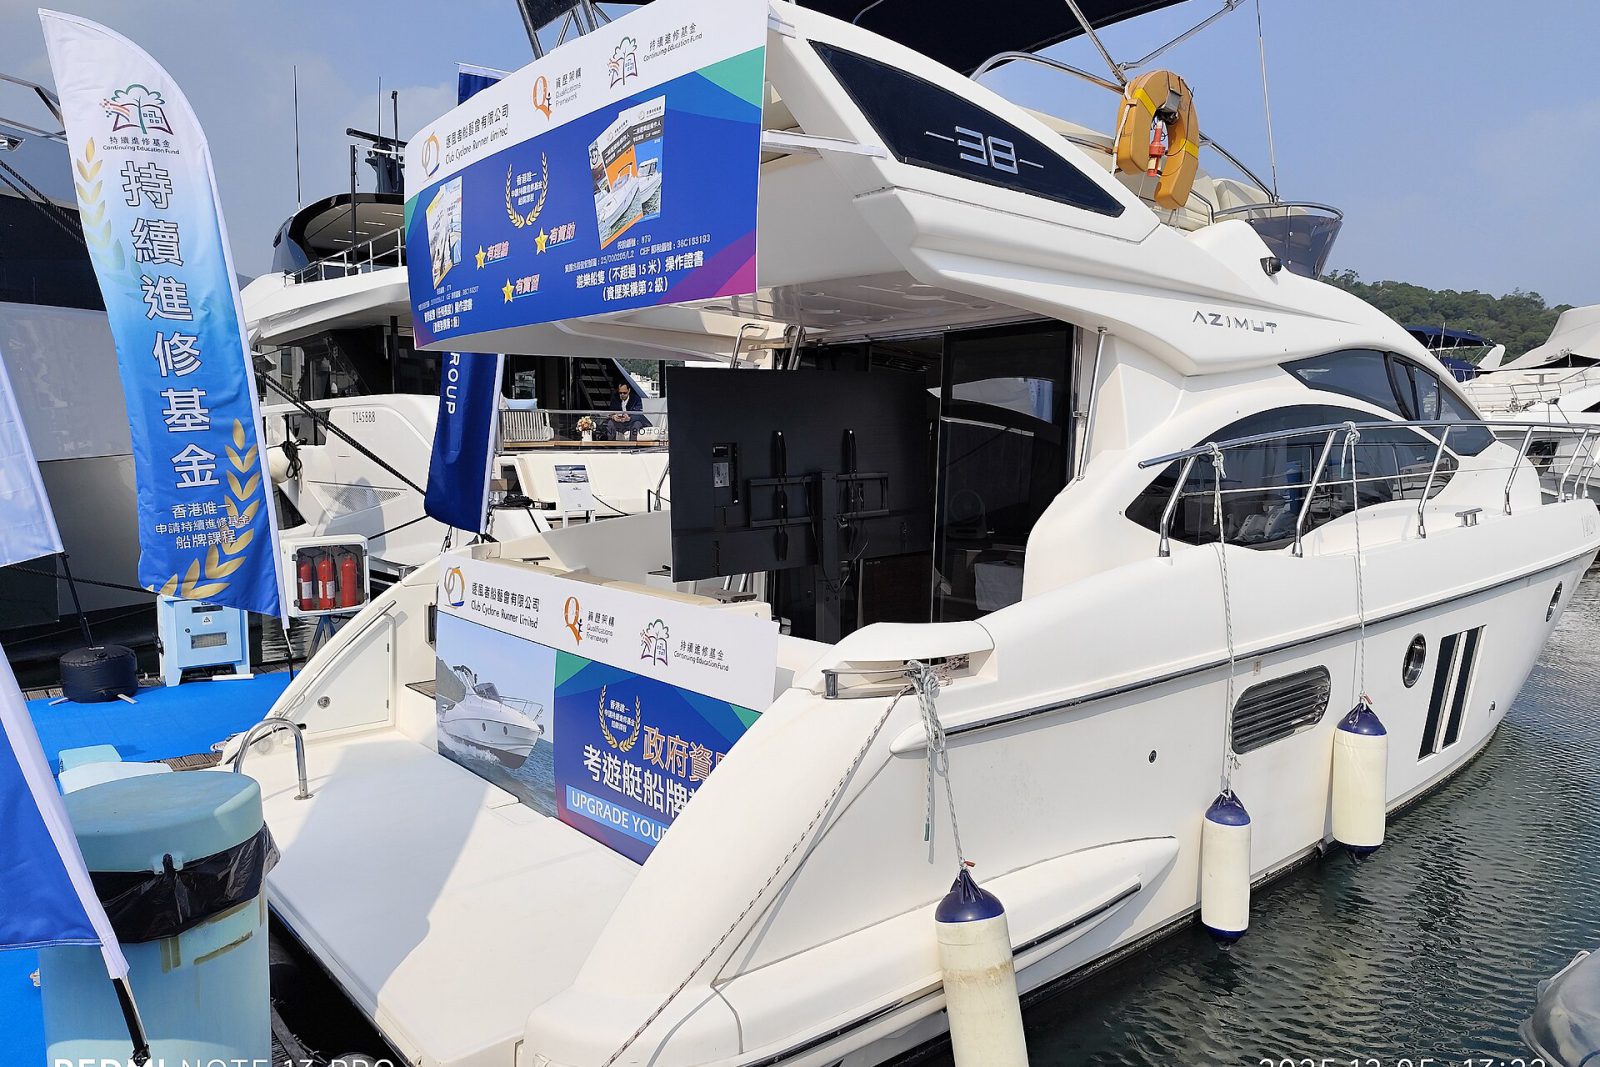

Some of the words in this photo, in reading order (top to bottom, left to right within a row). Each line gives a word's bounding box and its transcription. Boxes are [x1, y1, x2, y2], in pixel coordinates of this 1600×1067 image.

[102, 144, 136, 152] Continuing
[136, 145, 165, 154] Education
[120, 160, 220, 488] 持續進修基金
[1192, 309, 1279, 335] AZIMUT
[171, 500, 231, 520] 香港唯一
[176, 529, 237, 549] 船牌課程
[500, 608, 519, 622] Runner
[519, 613, 539, 629] Limited
[583, 744, 697, 819] 考遊艇船牌
[572, 790, 629, 829] UPGRADE
